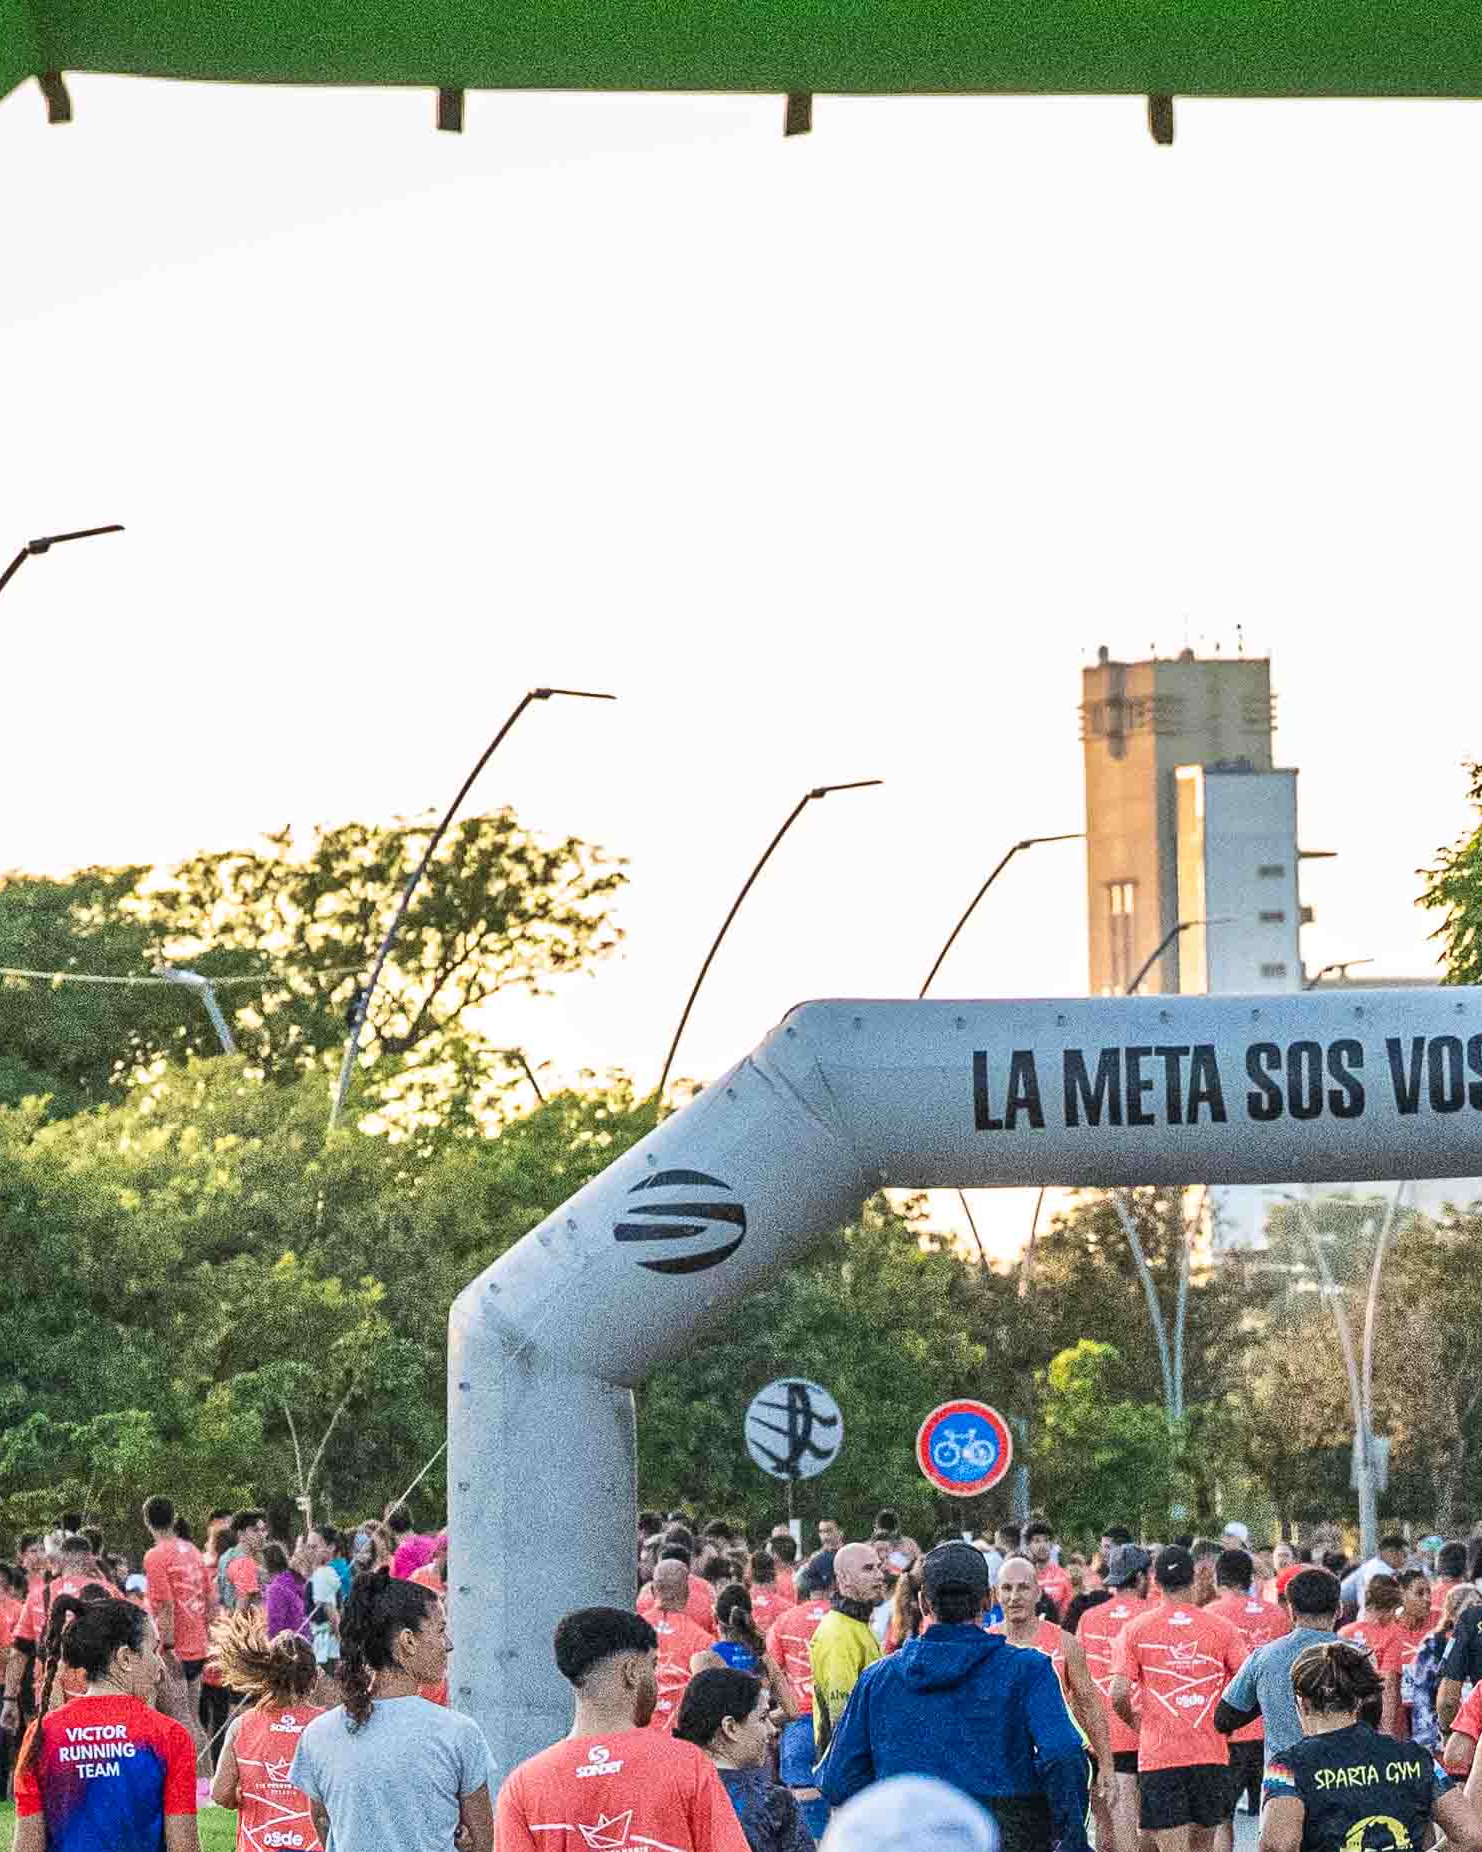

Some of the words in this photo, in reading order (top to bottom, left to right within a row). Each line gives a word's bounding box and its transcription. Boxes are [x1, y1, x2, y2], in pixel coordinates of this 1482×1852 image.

[972, 1050, 1046, 1132] LA
[1063, 1044, 1228, 1128] META
[1245, 1038, 1366, 1122] SOS
[65, 1725, 127, 1742] VICTOR
[59, 1742, 136, 1762] RUNNING
[76, 1762, 120, 1779] TEAM
[1314, 1764, 1379, 1790] SPARTA
[1385, 1761, 1421, 1785] GYM
